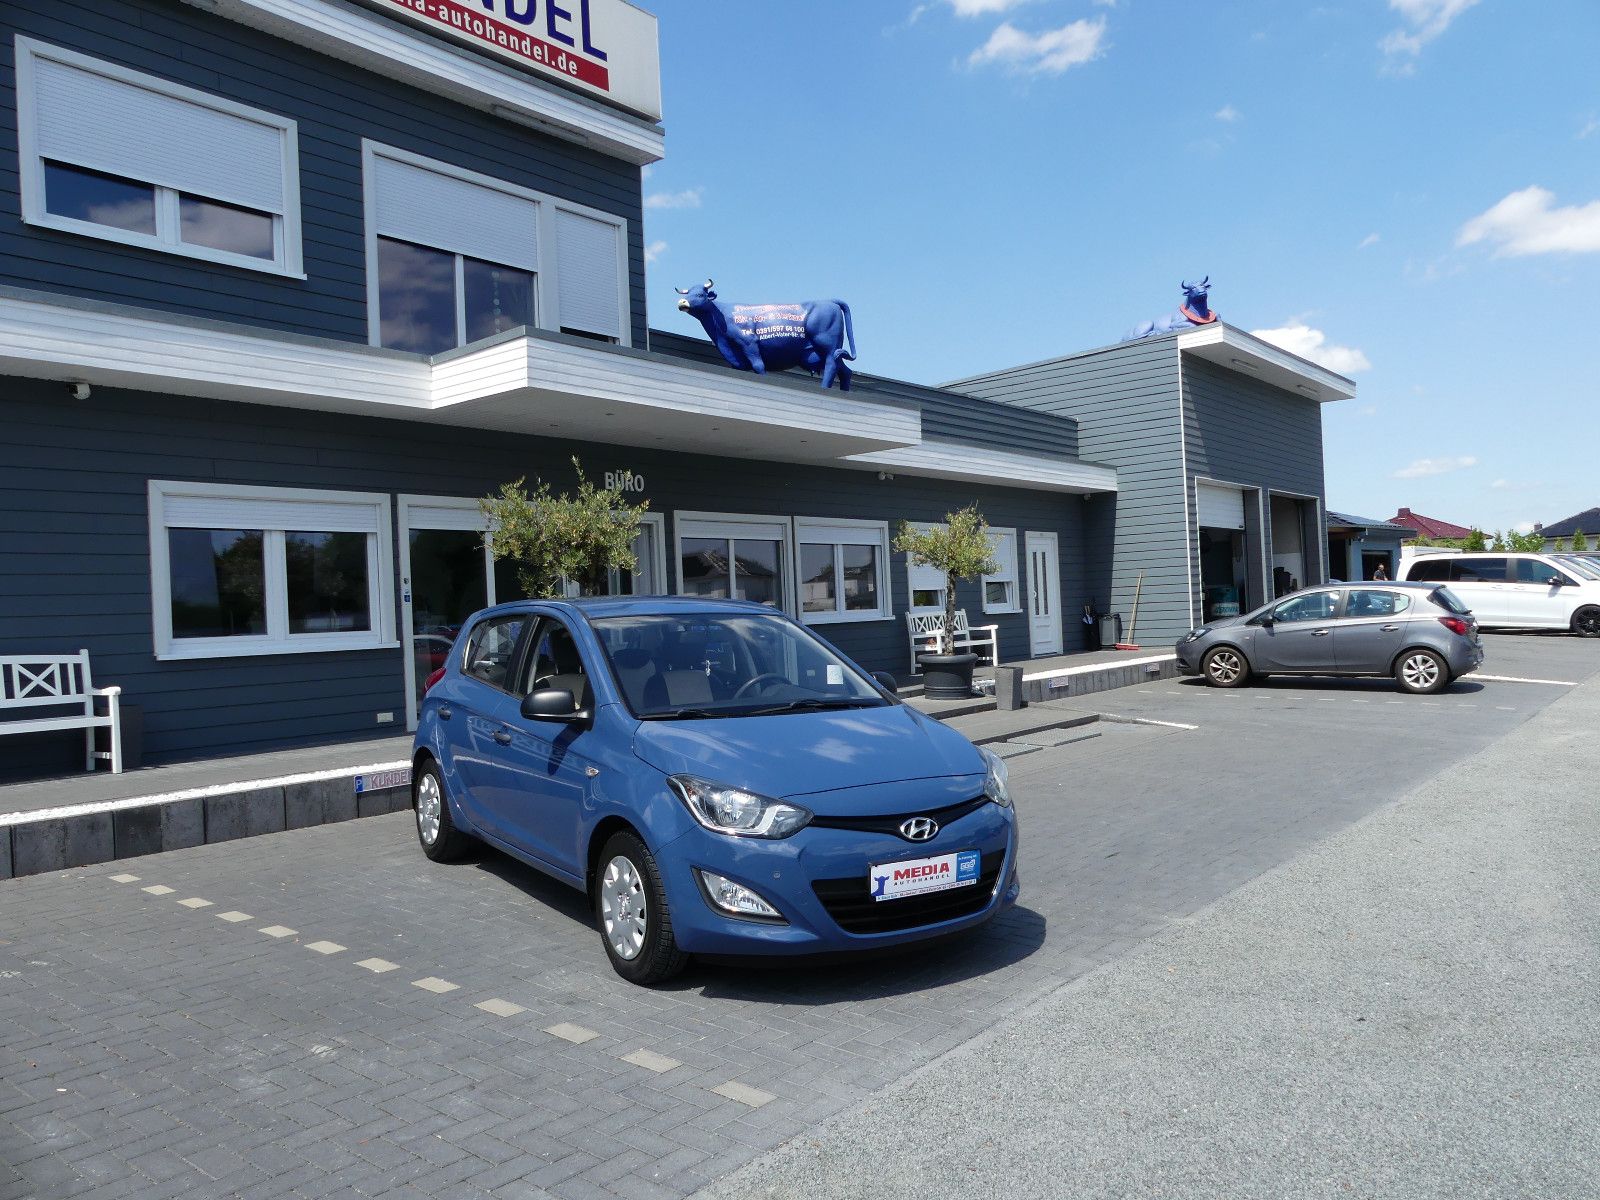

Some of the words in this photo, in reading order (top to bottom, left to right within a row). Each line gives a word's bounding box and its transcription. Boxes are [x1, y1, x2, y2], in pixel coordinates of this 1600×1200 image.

[396, 0, 578, 75] a-autohandel.de
[468, 0, 608, 62] EL
[604, 469, 645, 493] BÜRO
[893, 862, 950, 881] MEDIA
[893, 873, 950, 886] AUTOHANDEL
